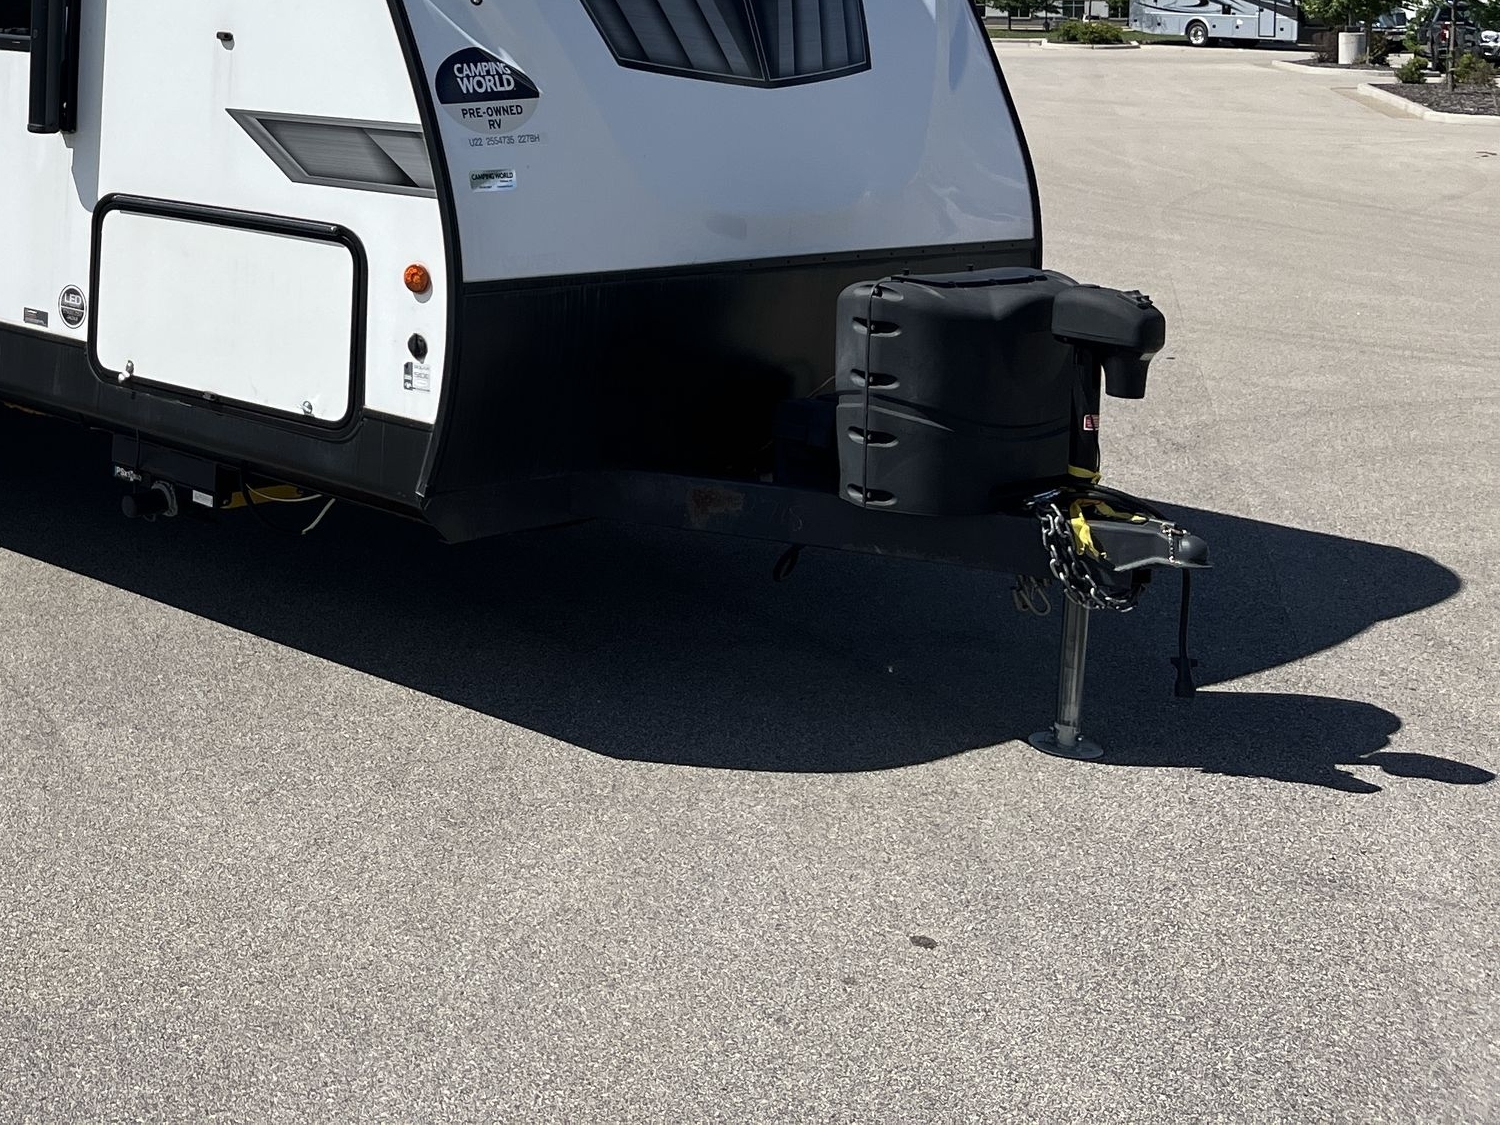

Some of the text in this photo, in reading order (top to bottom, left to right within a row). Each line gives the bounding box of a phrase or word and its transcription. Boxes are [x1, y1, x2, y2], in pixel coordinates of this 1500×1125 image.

[453, 61, 511, 78] CAMPING
[456, 75, 515, 94] WORLD
[461, 104, 523, 120] PRE-OWNED
[488, 119, 502, 130] RV
[468, 138, 483, 147] U22
[64, 292, 82, 305] LED
